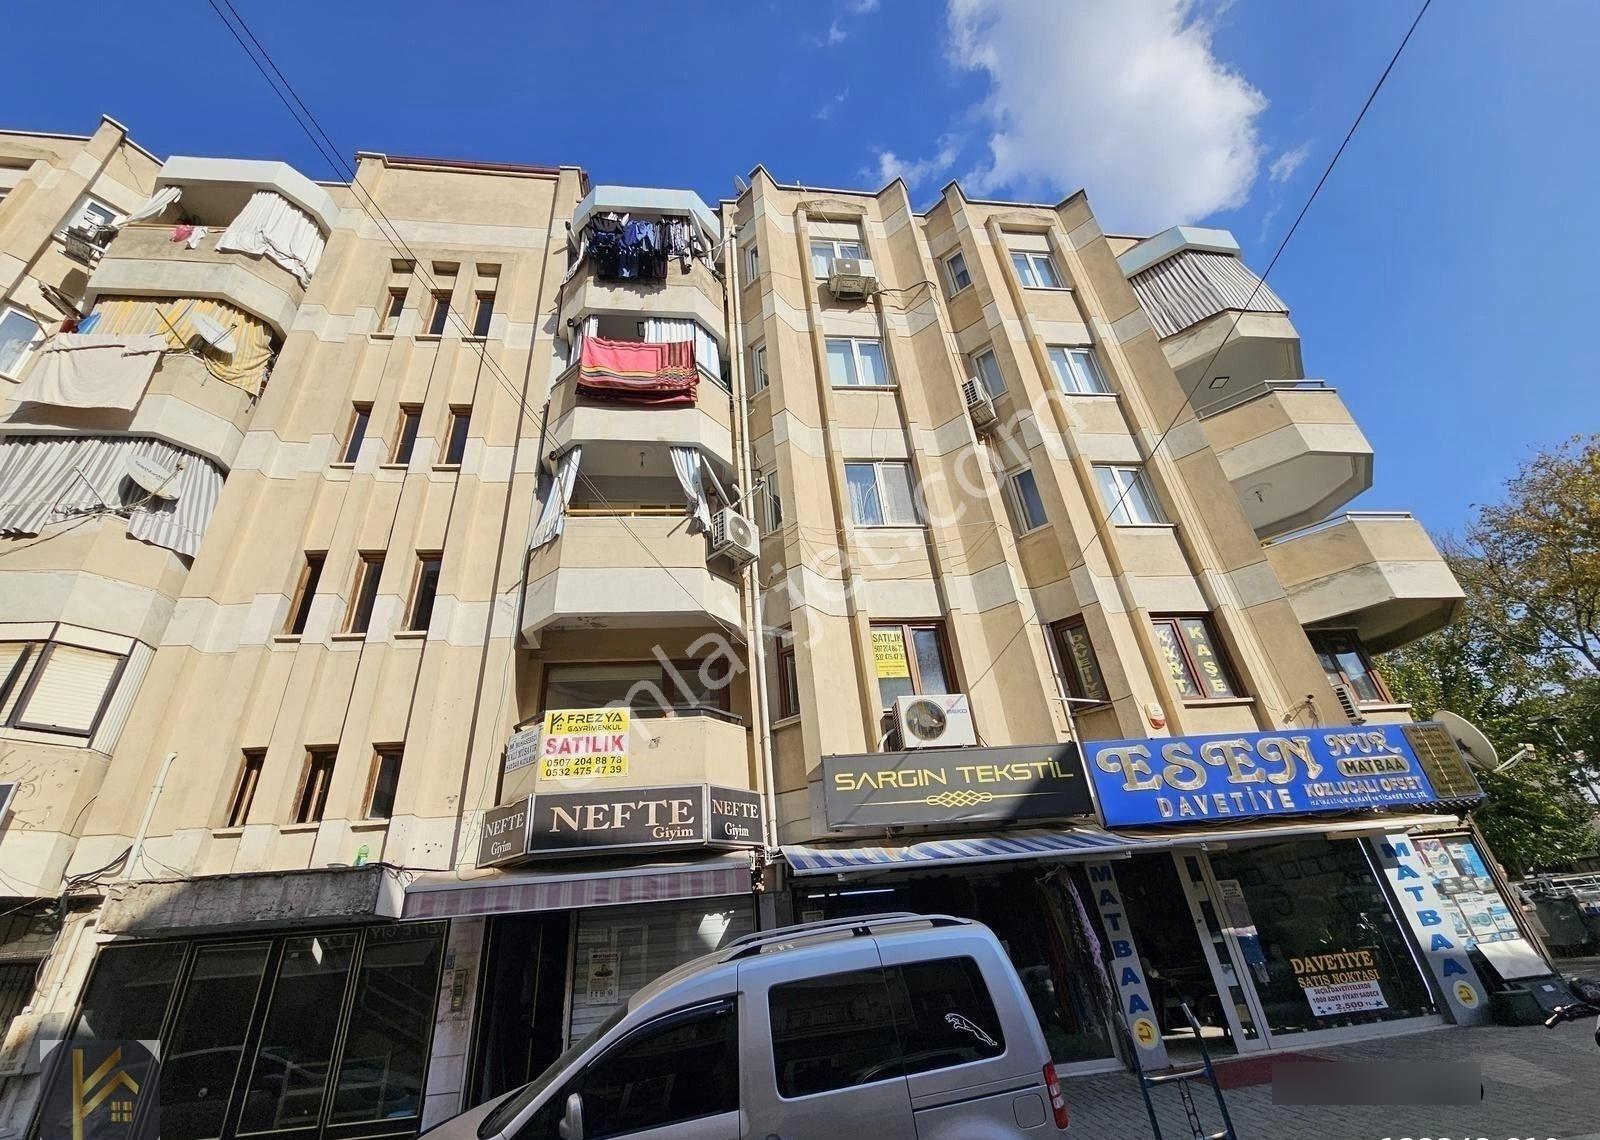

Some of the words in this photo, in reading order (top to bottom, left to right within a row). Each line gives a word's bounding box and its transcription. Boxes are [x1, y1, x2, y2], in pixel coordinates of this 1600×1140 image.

[1188, 626, 1227, 692] KAŞE
[566, 712, 623, 724] FREZYA
[567, 724, 622, 732] GAYRİMENKUL
[545, 734, 625, 755] SATILIK
[545, 768, 570, 777] 0532
[573, 767, 591, 776] 475
[594, 767, 606, 775] 47
[609, 766, 622, 774] 39
[547, 759, 570, 767] 0507
[574, 757, 592, 766] 204
[595, 757, 607, 765] 88
[610, 756, 622, 764] 78
[1096, 735, 1323, 792] ESEN
[1323, 731, 1402, 756] NUR
[1343, 757, 1406, 775] MATBAA
[834, 767, 947, 791] SARGIN
[955, 757, 1074, 784] TEKSTİL
[1302, 778, 1381, 798] KOZLUCALI
[1381, 776, 1424, 792] OFSET
[711, 798, 759, 819] NEFTE
[1155, 786, 1296, 818] DAVETİYE
[484, 812, 524, 837] NEFTE
[549, 799, 695, 833] NEFTE
[652, 826, 694, 841] Giyim
[724, 822, 750, 840] Giyim
[490, 841, 512, 857] Giyim
[1380, 842, 1468, 978] MATBAA
[1088, 866, 1150, 1014] MATBAA
[1289, 948, 1374, 974] DAVETİYE
[1331, 968, 1381, 984] NOKTASI
[1335, 1001, 1364, 1010] 2.500
